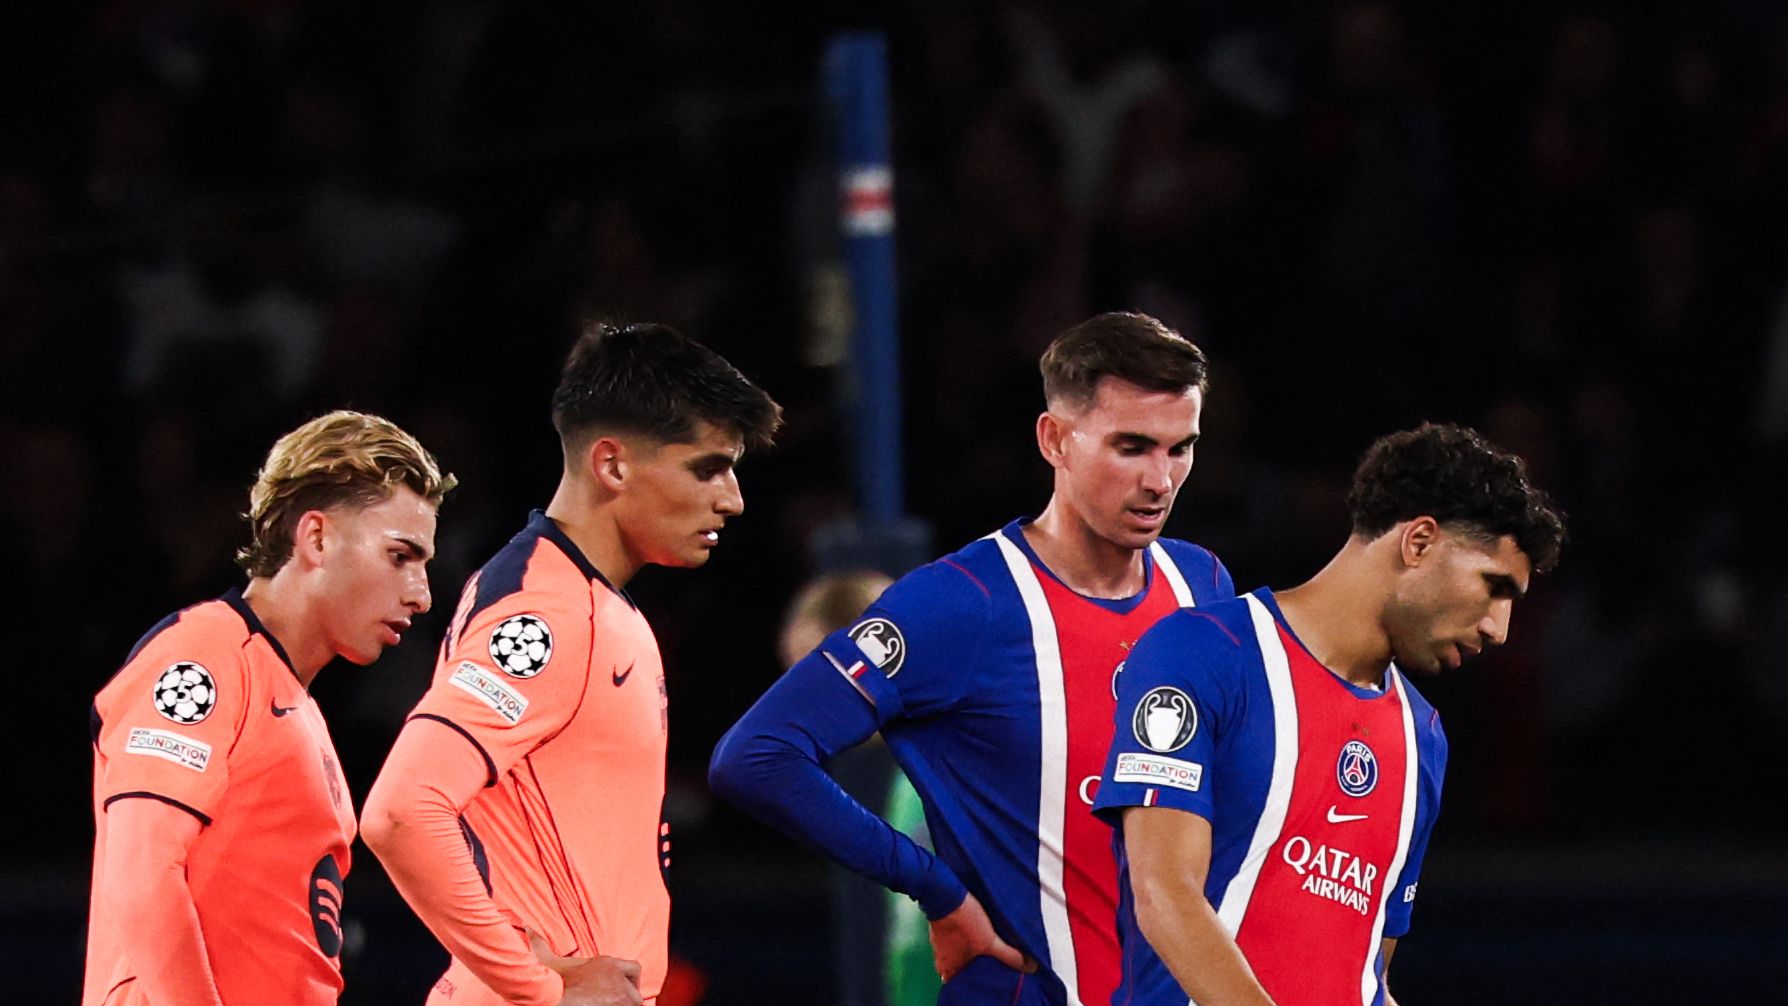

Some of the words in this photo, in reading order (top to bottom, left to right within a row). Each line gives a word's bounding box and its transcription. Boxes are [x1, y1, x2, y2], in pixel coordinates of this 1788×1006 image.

[456, 668, 524, 716] FOUNDATION
[130, 735, 208, 762] FOUNDATION
[1346, 744, 1373, 763] PARIS
[1119, 762, 1198, 781] FOUNDATION
[1283, 836, 1378, 896] QATAR
[1301, 874, 1370, 916] AIRWAYS
